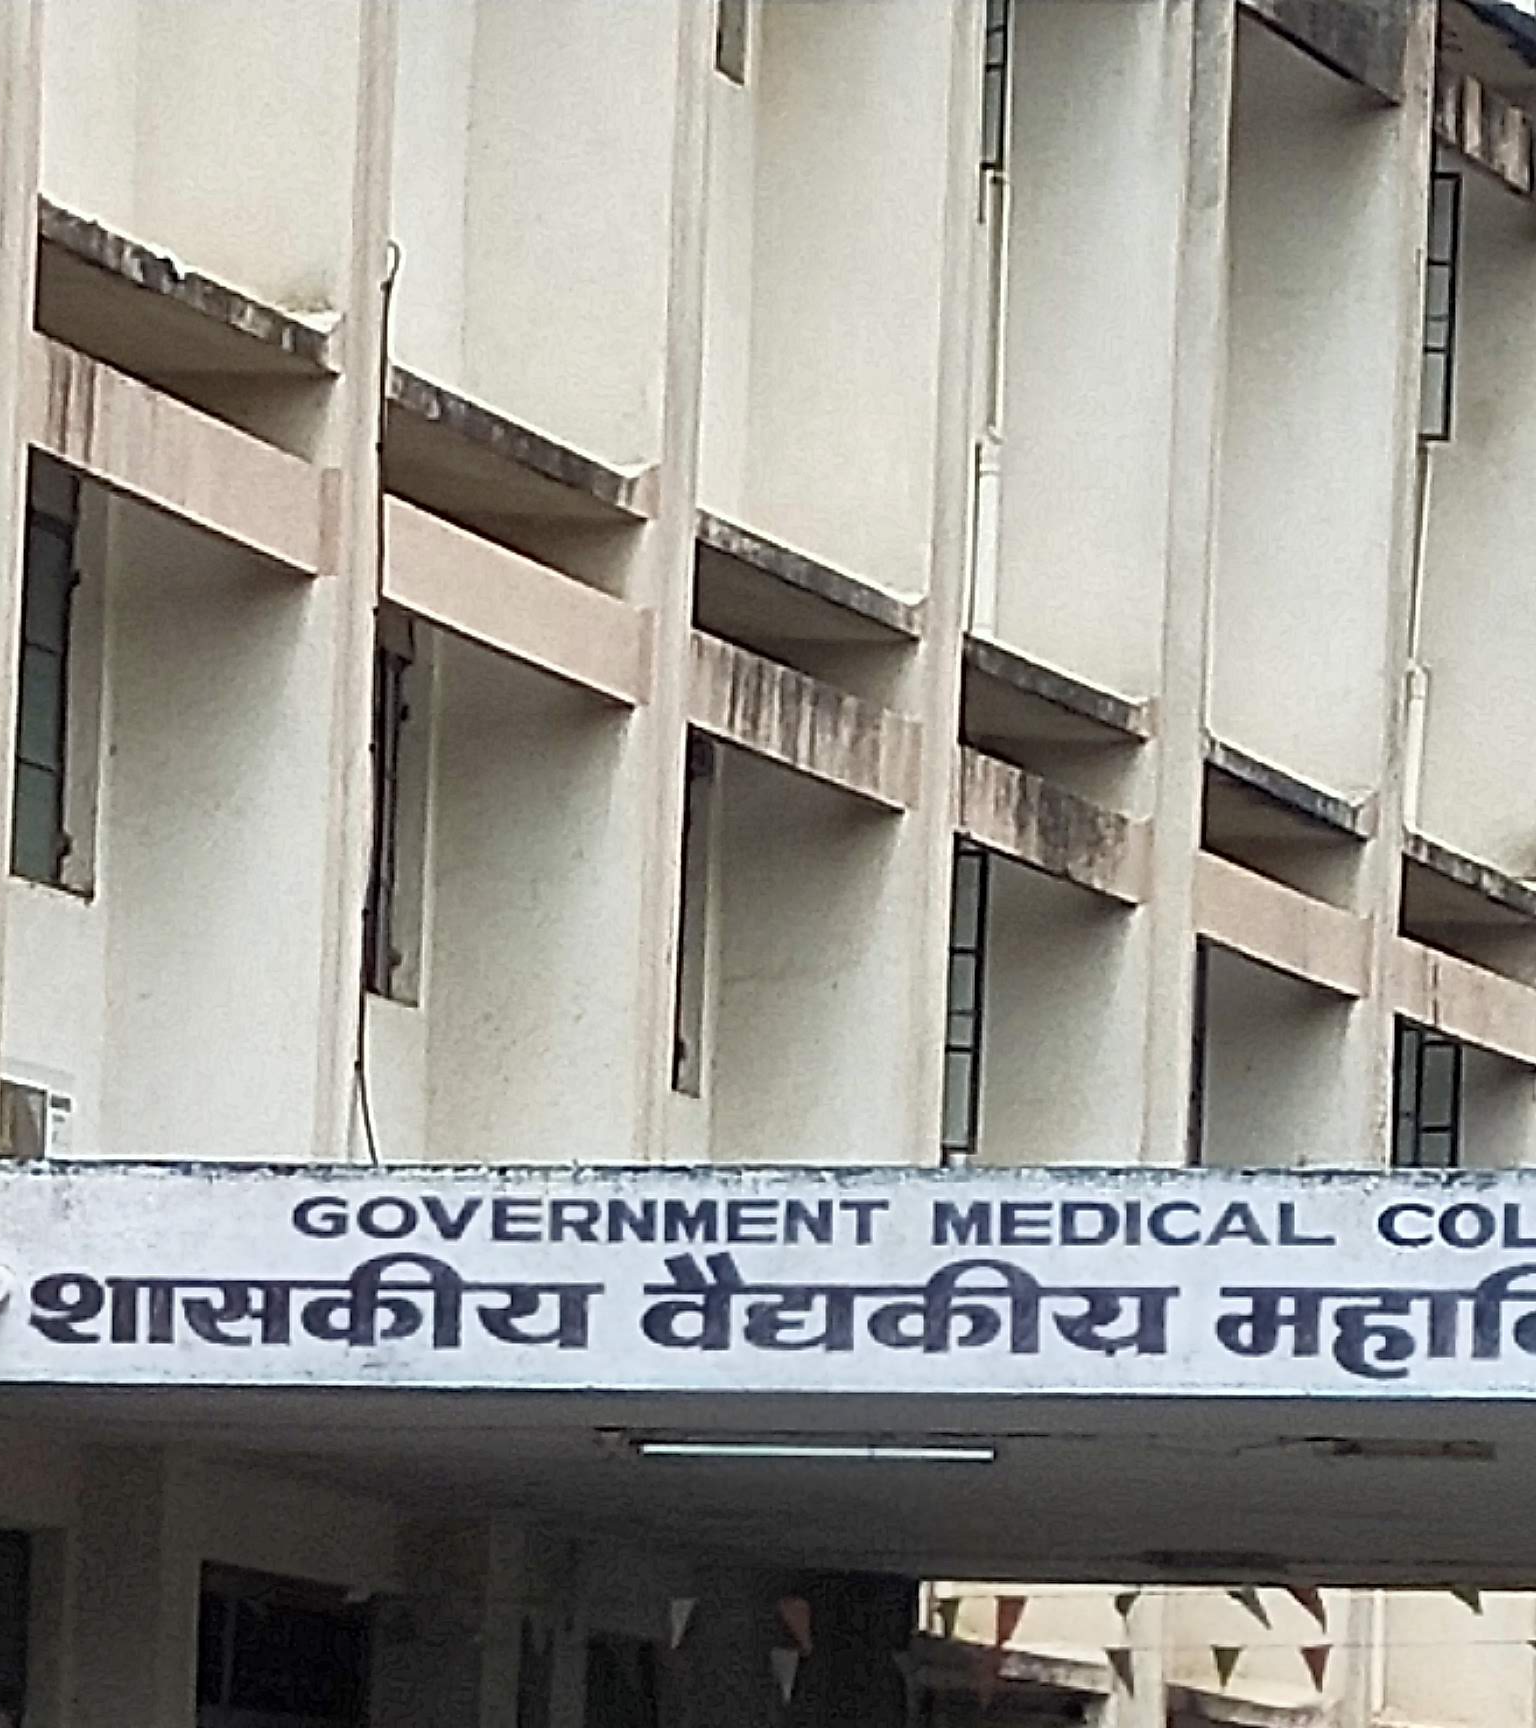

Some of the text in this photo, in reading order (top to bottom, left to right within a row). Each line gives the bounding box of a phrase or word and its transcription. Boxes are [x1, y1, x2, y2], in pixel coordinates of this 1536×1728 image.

[292, 1195, 890, 1247] GOVERNMENT
[931, 1199, 1337, 1247] MEDICAL
[28, 1251, 606, 1350] शासकीय
[639, 1250, 1181, 1358] वैद्यकीय
